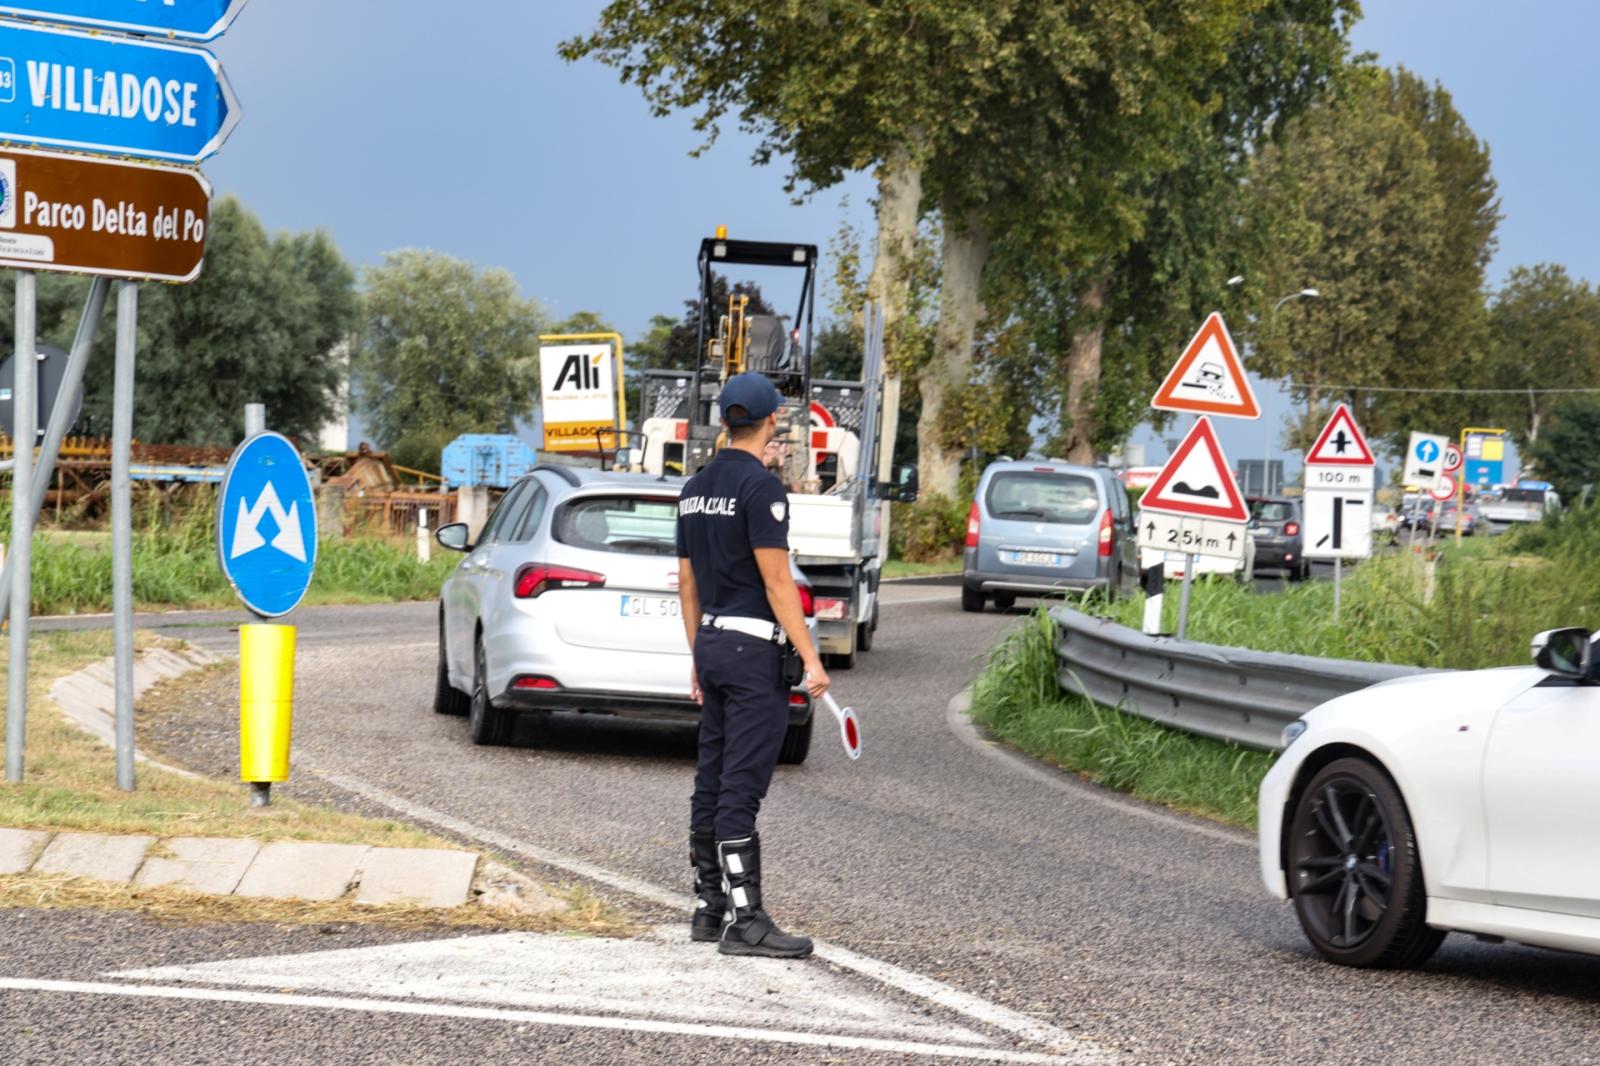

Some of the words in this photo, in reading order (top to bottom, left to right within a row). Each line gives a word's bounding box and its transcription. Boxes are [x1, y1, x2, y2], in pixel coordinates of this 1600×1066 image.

[26, 60, 199, 127] VILLADOSE
[24, 190, 85, 231] Parco
[92, 197, 148, 238] Delta
[153, 205, 179, 241] del
[183, 209, 205, 243] Po
[1319, 472, 1344, 483] 100
[1349, 475, 1361, 483] m
